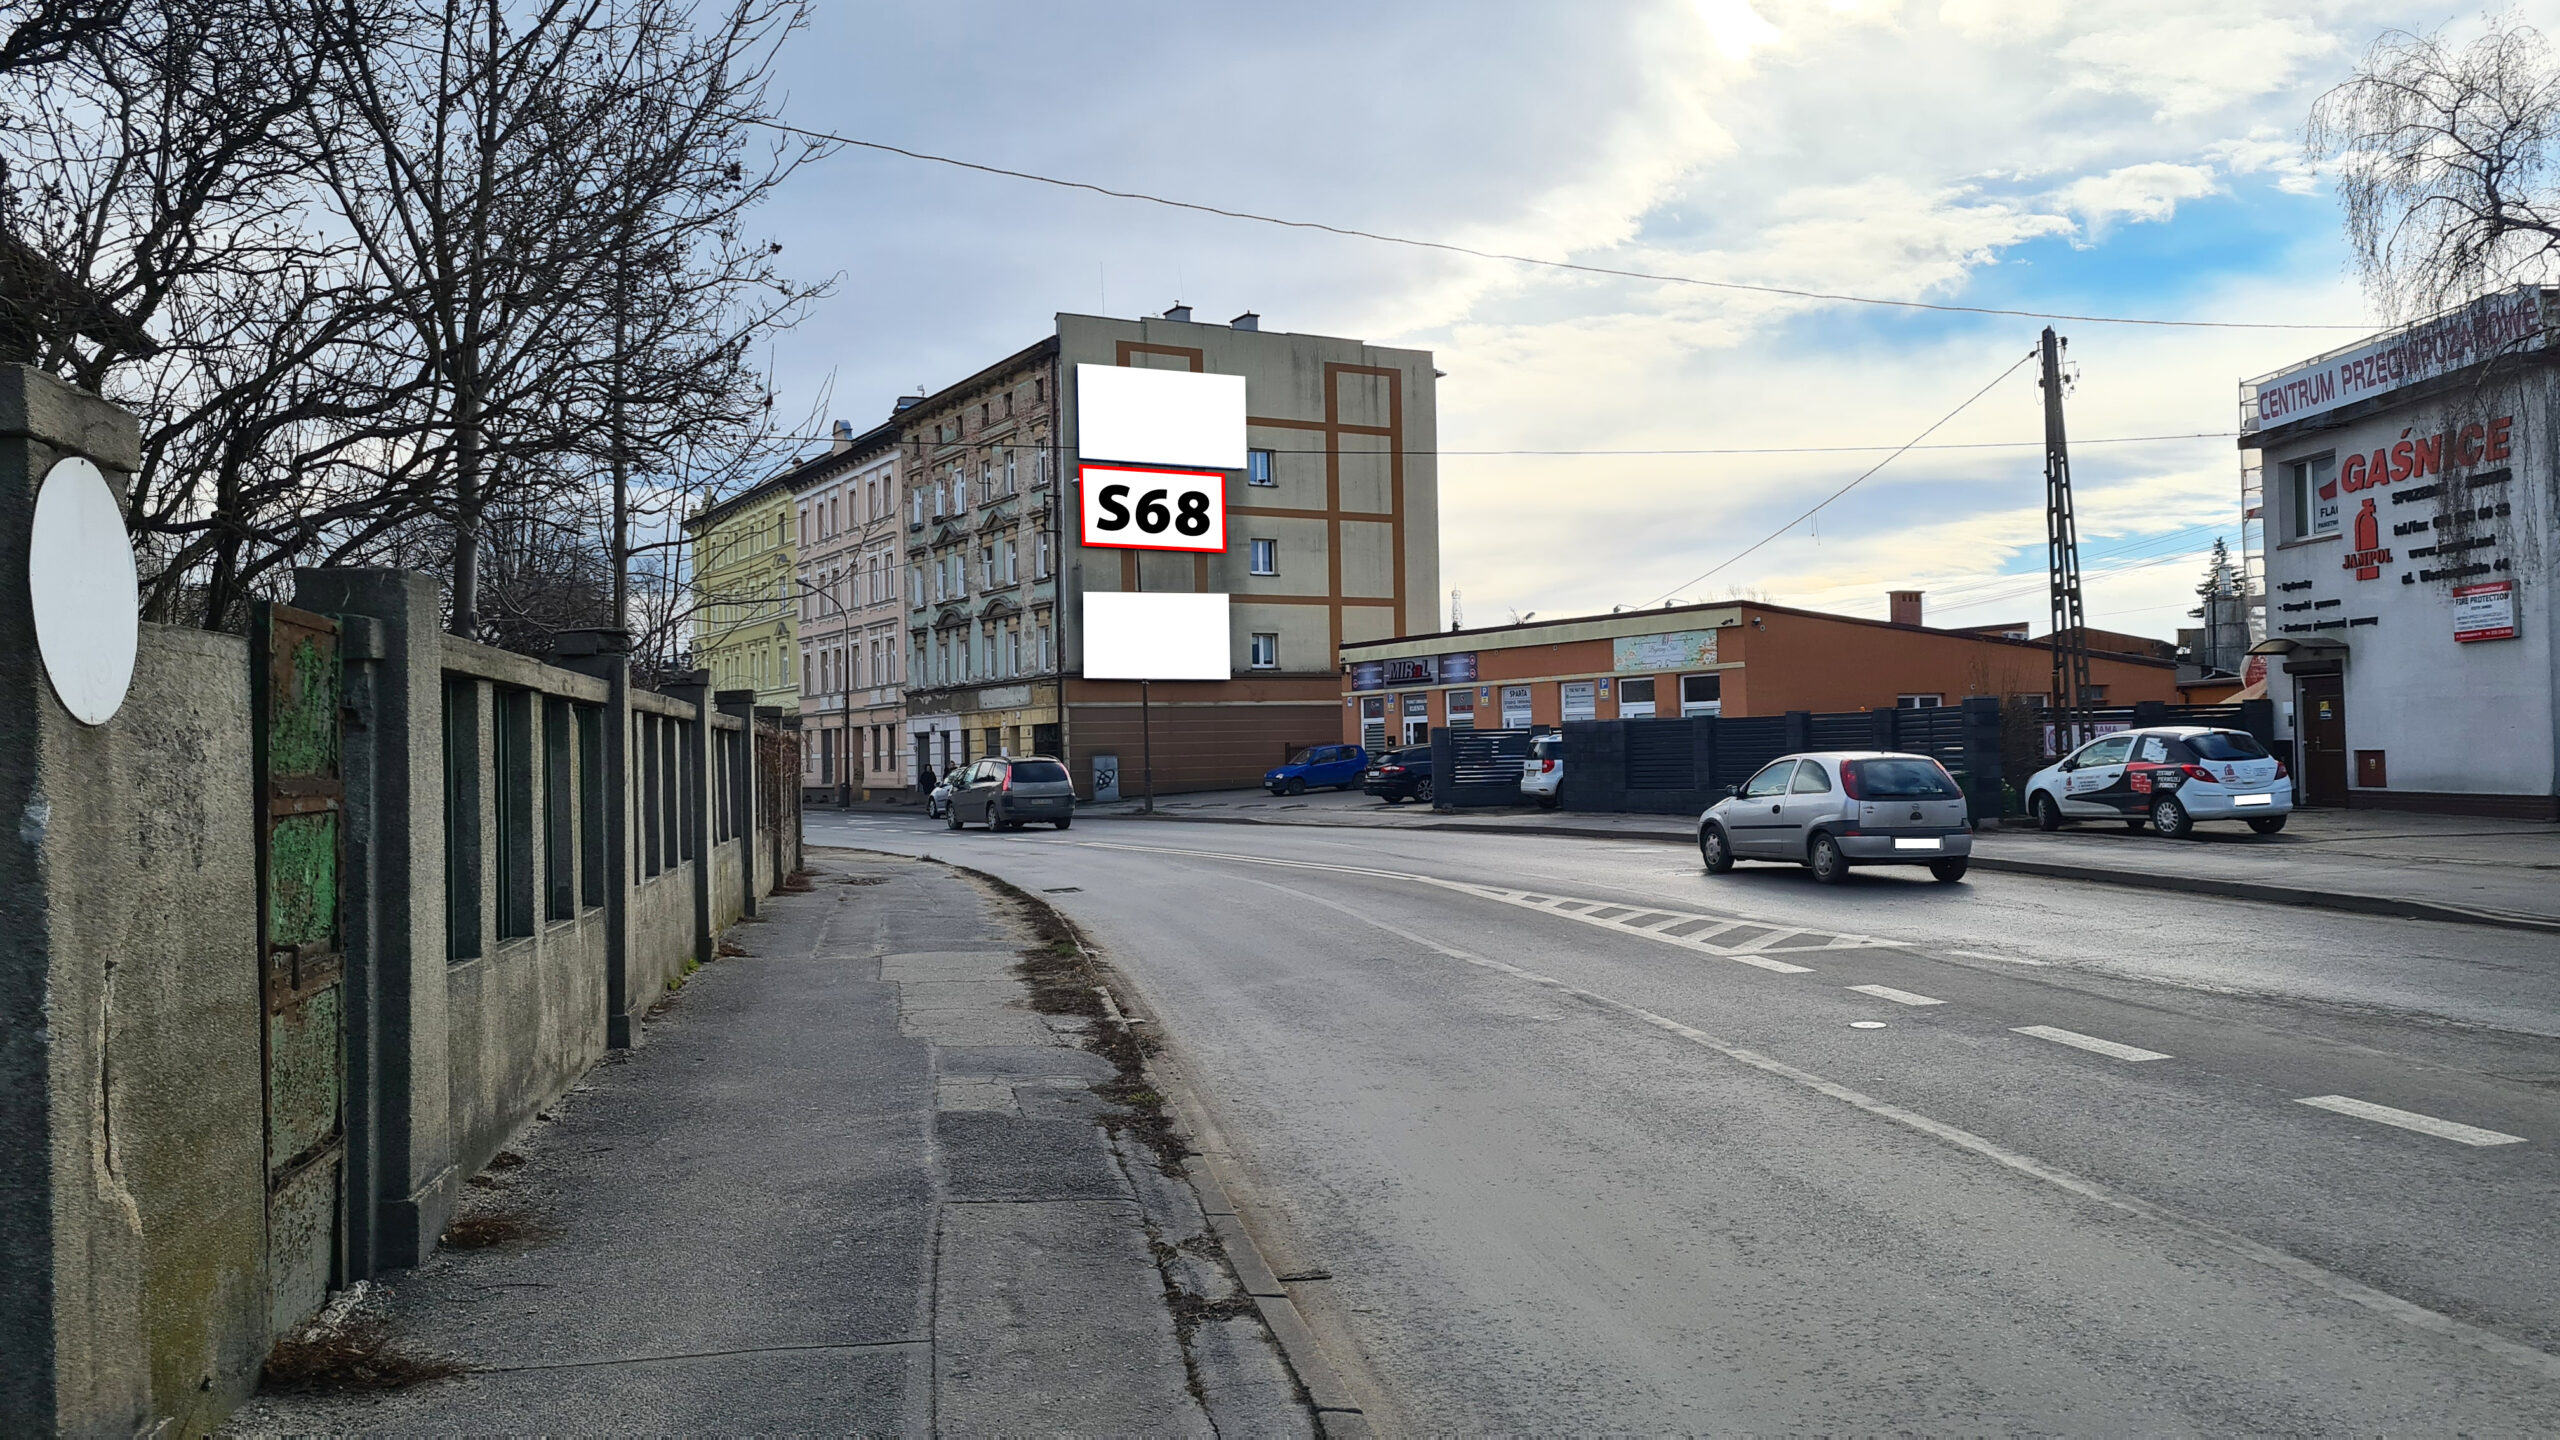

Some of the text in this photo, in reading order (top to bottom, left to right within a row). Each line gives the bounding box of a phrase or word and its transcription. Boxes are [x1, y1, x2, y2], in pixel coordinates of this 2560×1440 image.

[2259, 371, 2336, 421] CENTRUM
[2341, 416, 2513, 494] GAŚNICE
[1096, 484, 1211, 537] S68
[2455, 592, 2510, 606] FIRE PROTECTION
[1509, 688, 1528, 698] SPARTA
